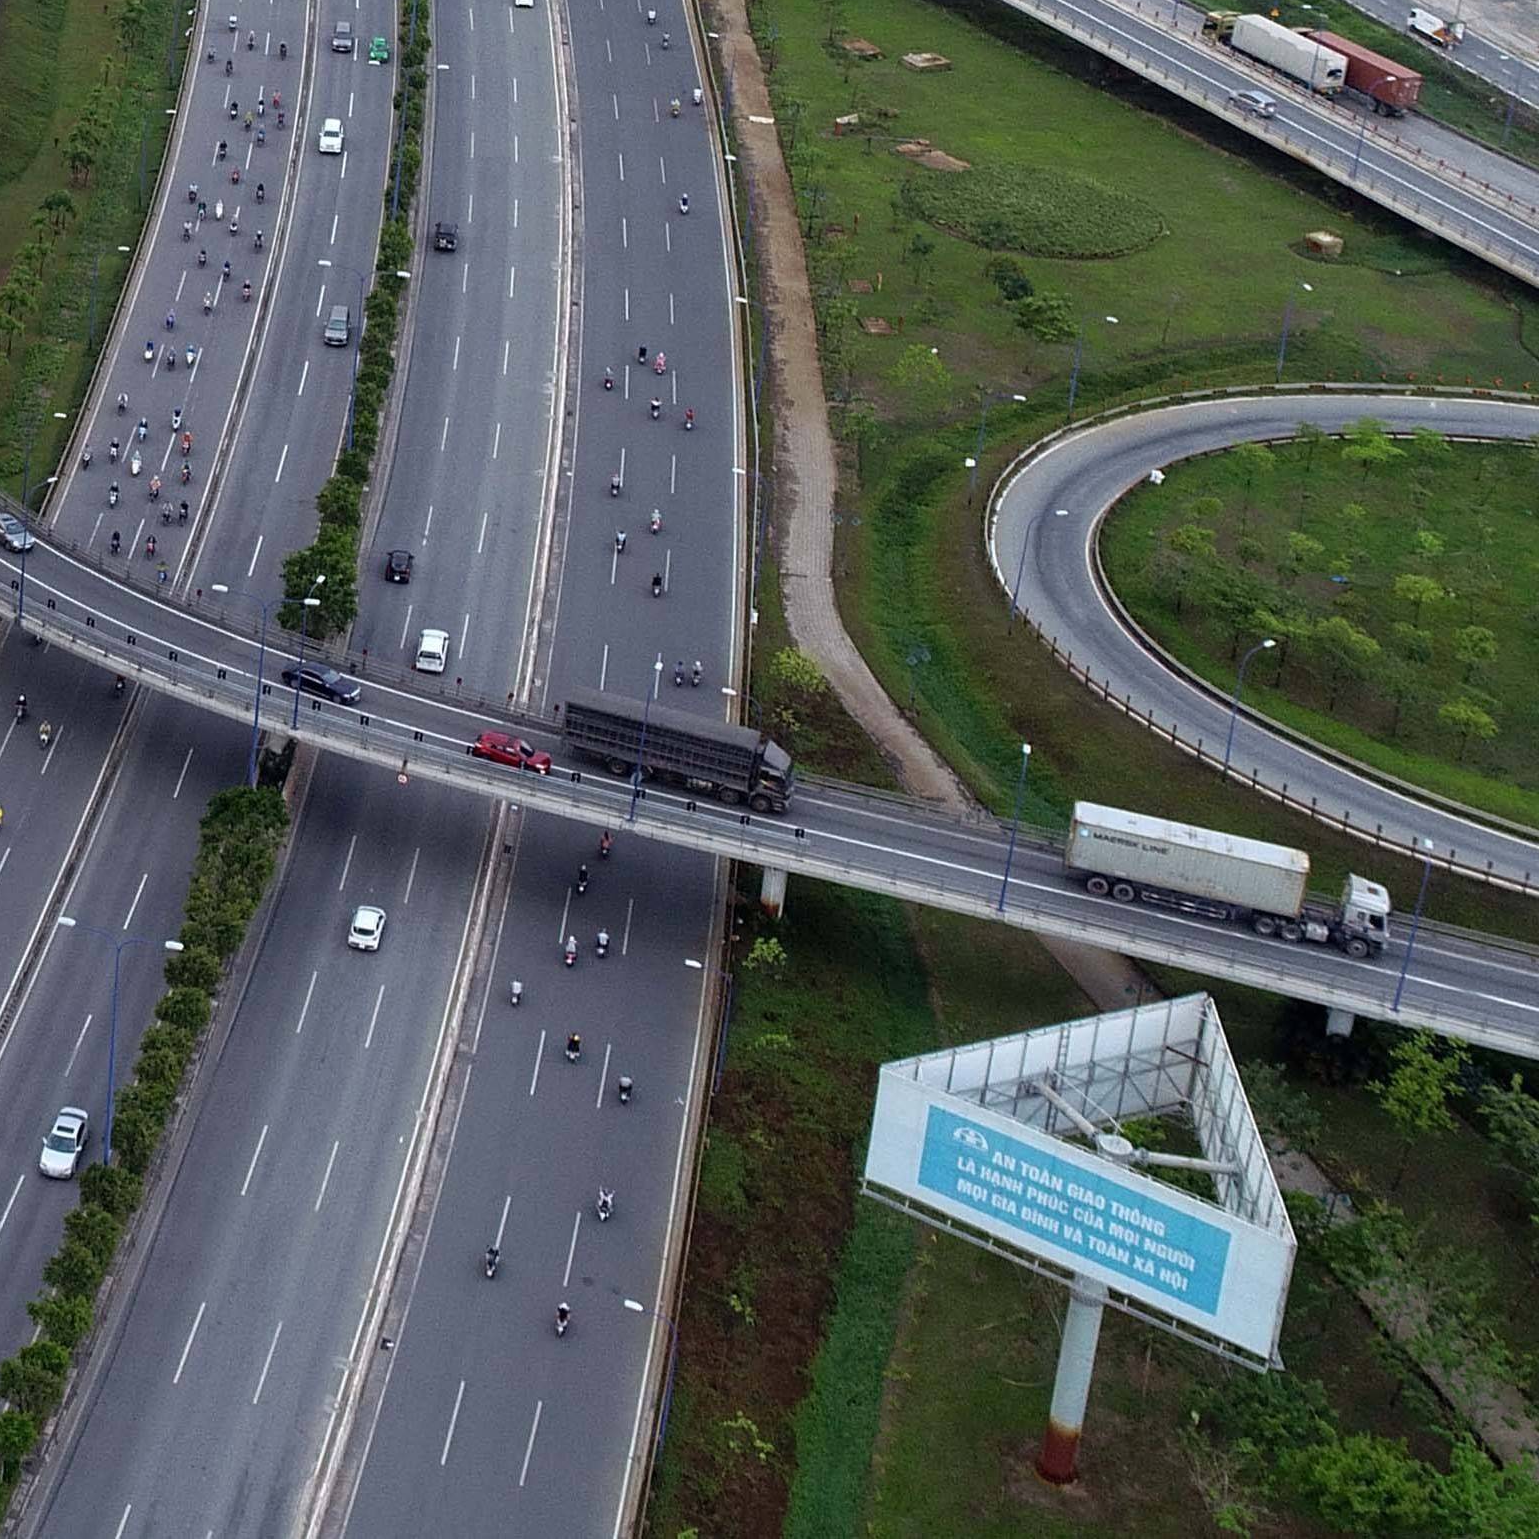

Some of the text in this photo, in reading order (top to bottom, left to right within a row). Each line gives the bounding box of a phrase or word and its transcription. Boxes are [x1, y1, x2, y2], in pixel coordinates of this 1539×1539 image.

[1093, 832, 1170, 855] MAERSK LINE
[957, 1178, 988, 1201] MỌI
[991, 1193, 1017, 1216] GIA
[1088, 1235, 1130, 1265] TOÀN
[980, 1165, 1023, 1195] HẠNH
[1027, 1185, 1069, 1214] PHÚC
[1109, 1222, 1140, 1247] MỌI
[992, 1151, 1165, 1237] AN TOÀN GIAO THÔNG
